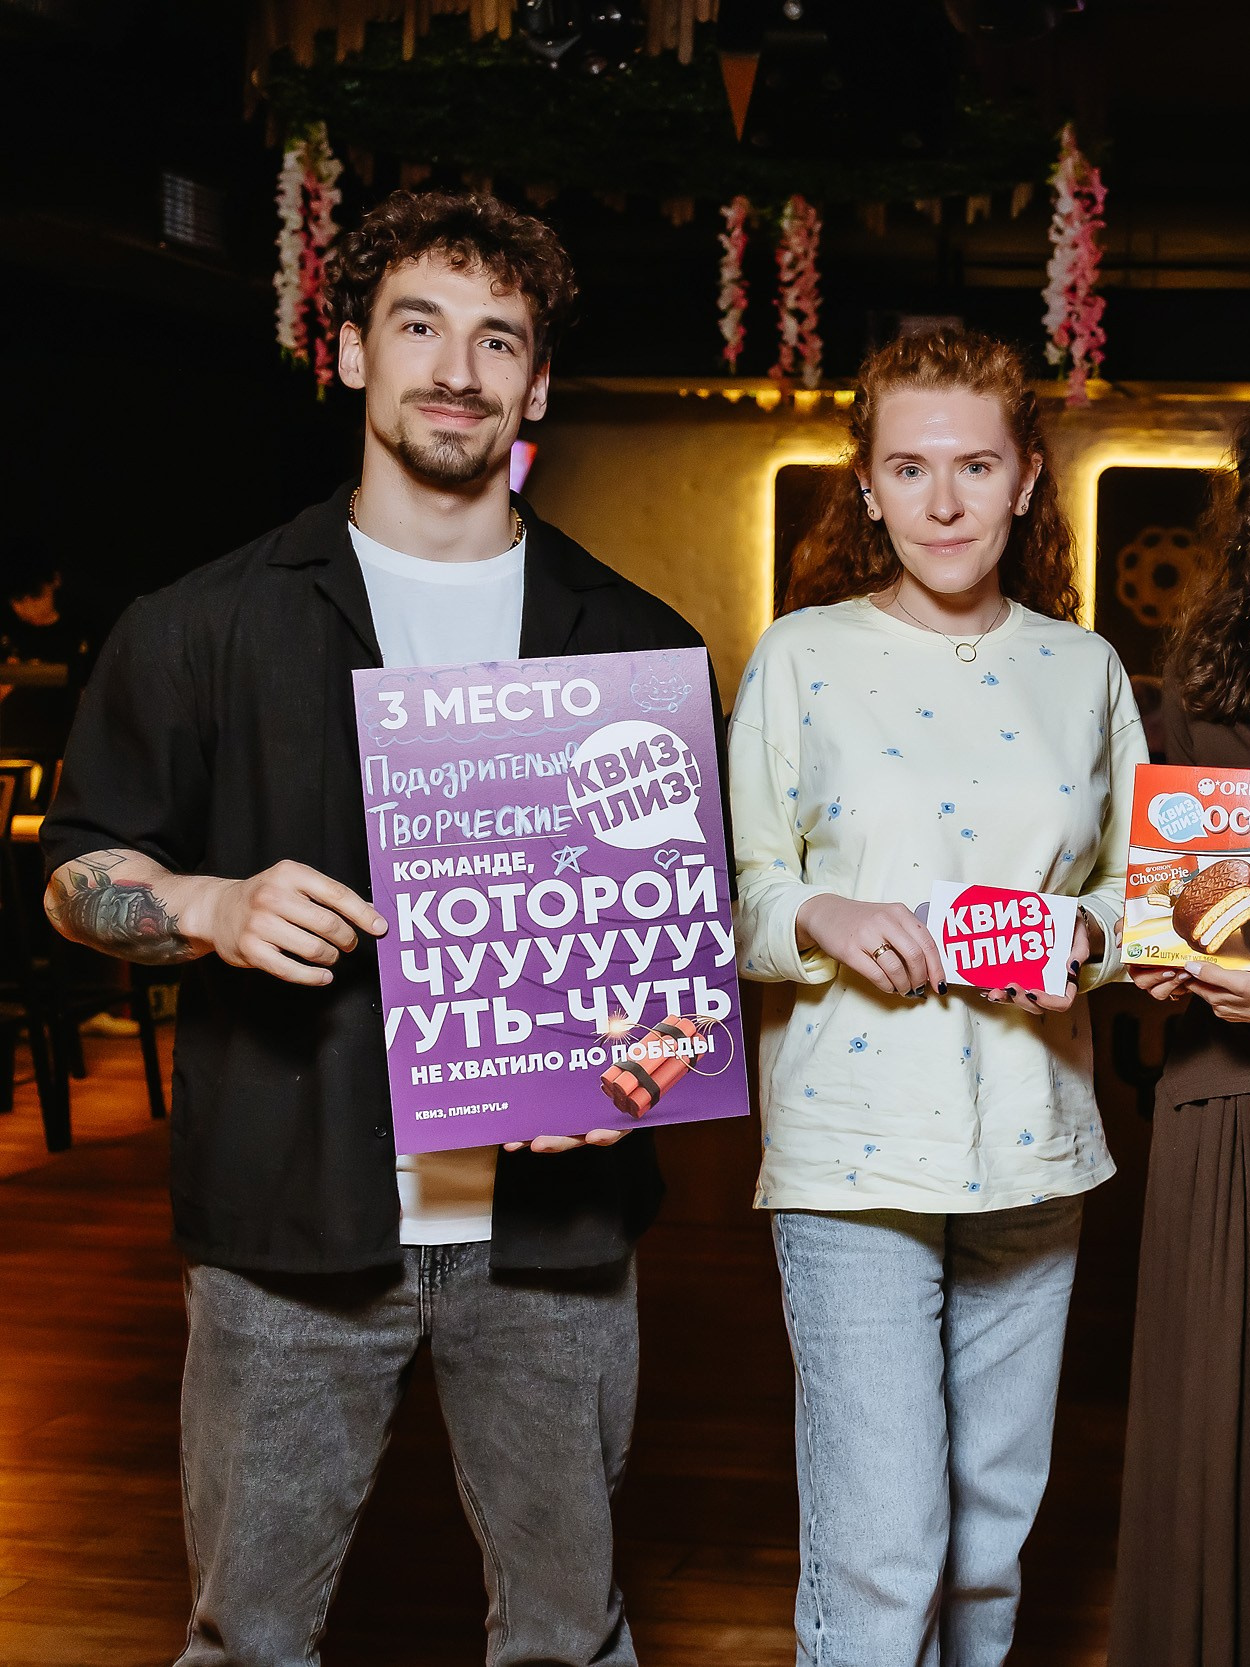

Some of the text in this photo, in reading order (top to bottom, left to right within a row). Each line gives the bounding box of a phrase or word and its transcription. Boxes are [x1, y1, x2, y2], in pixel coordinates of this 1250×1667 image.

[378, 679, 601, 730] 3 МЕСТО
[392, 852, 535, 882] КОМАНДЕ,
[396, 854, 718, 942] КОТОРОЙ
[946, 929, 1054, 971] ПЛИЗ!
[1144, 945, 1160, 959] 12
[411, 1034, 715, 1085] НЕ ХВАТИЛО ДО ПОБЕДЫ
[415, 1109, 447, 1120] КВИЗ,
[448, 1104, 480, 1117] ПЛИЗ!
